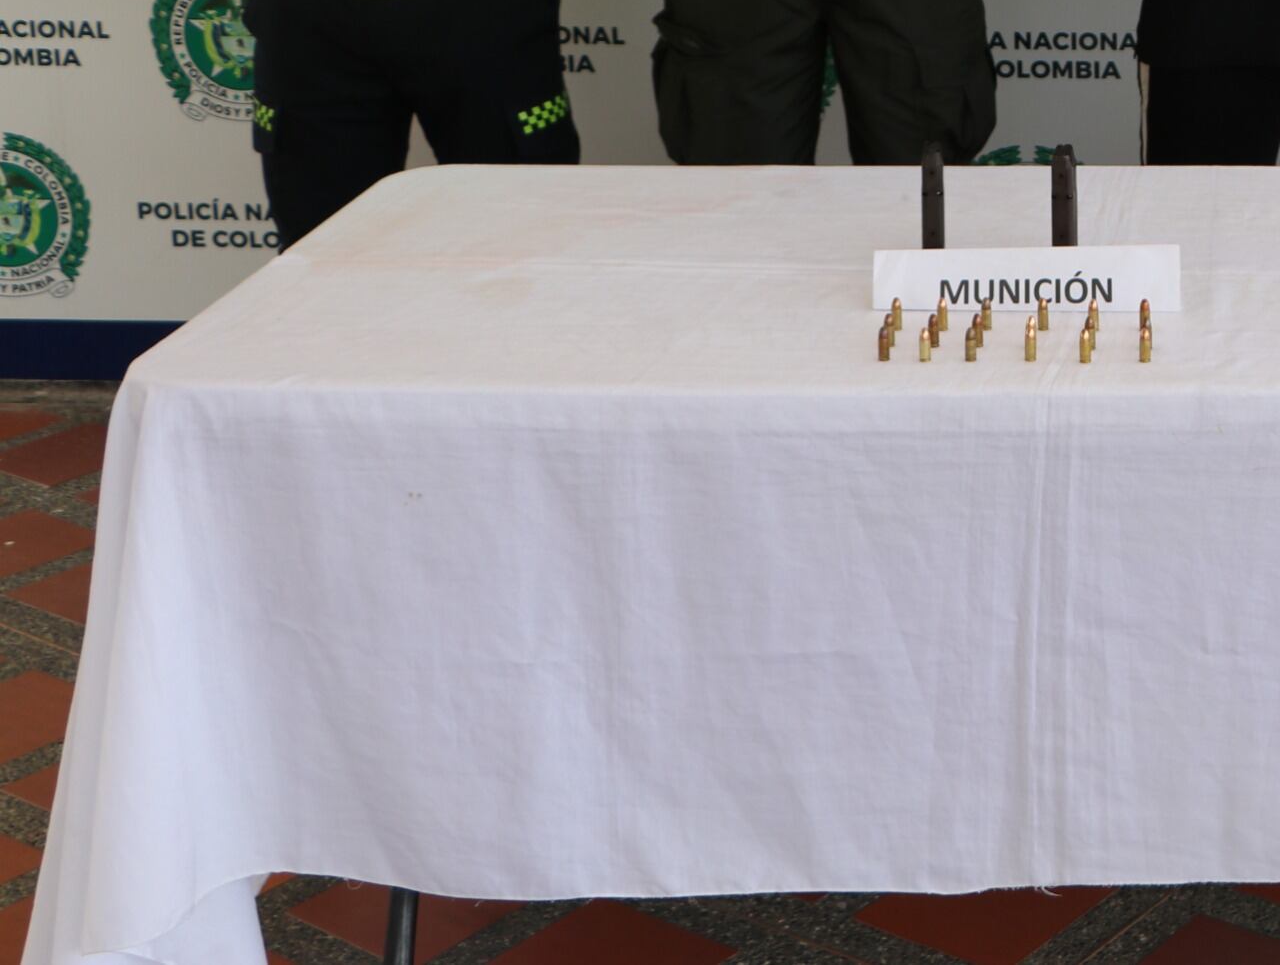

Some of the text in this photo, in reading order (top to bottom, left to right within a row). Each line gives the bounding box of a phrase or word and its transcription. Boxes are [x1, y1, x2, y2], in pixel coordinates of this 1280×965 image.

[0, 20, 110, 38] ACIONAL
[1014, 32, 1138, 50] NACIONA
[0, 48, 81, 66] OMBIA
[995, 60, 1120, 79] OLOMBIA
[138, 198, 238, 220] POLICÍA
[172, 230, 281, 248] DE COLO
[940, 270, 1113, 305] MUNICIÓN
